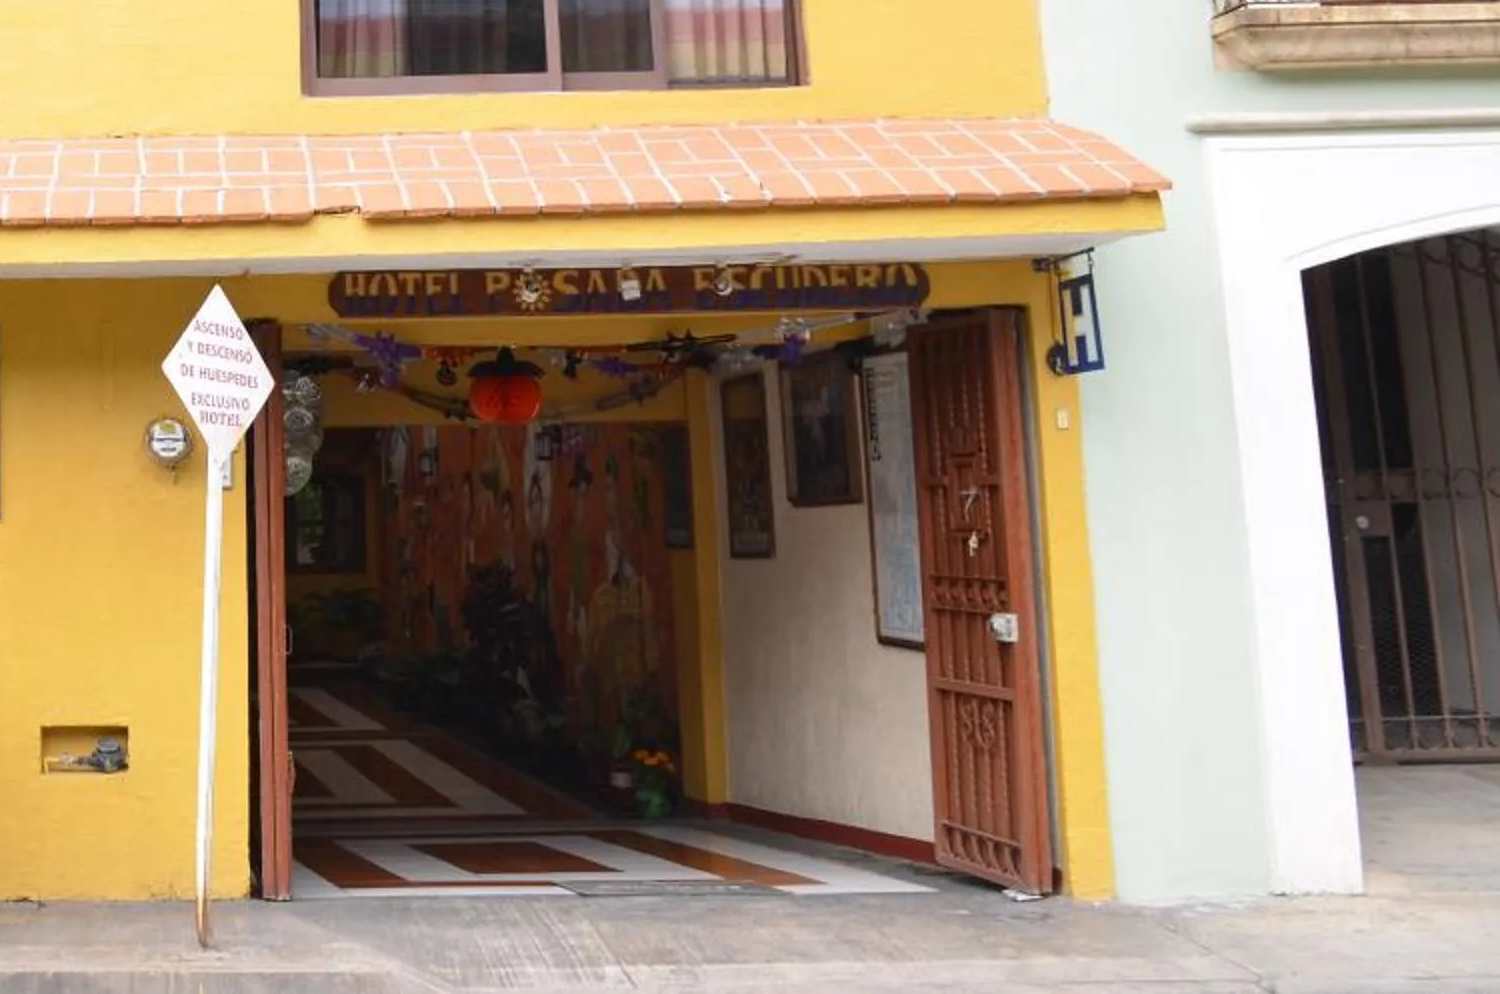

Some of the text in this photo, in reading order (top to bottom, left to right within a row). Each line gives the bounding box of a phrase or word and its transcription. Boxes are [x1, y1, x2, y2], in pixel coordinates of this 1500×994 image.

[193, 320, 245, 340] ASCENSO
[197, 341, 253, 364] DESCENSO
[180, 363, 259, 389] DE HUESPEDES
[191, 391, 251, 410] EXCLUSIVO
[199, 410, 243, 427] HOTEL
